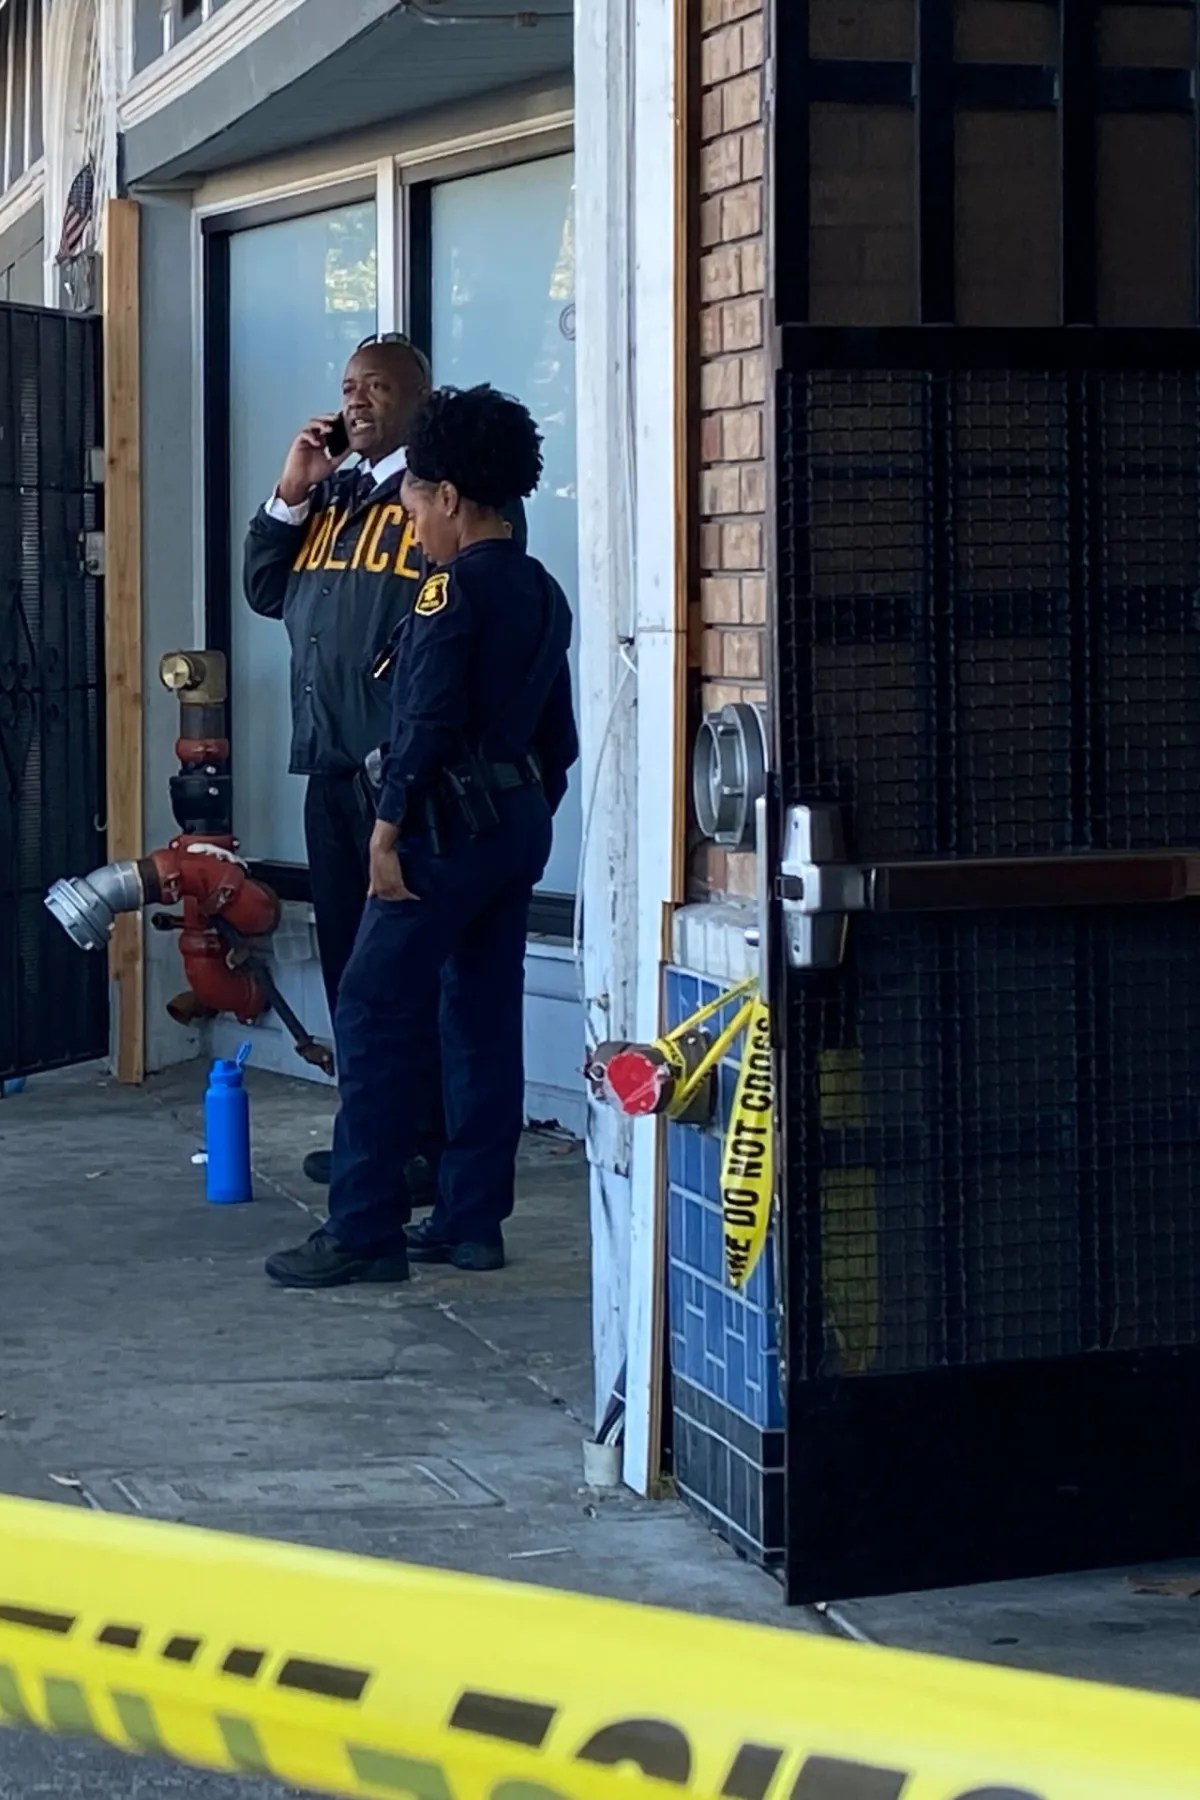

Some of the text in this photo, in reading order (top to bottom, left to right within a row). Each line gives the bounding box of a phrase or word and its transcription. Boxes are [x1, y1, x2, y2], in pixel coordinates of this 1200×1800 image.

[727, 1119, 767, 1178] NOT
[724, 1188, 760, 1227] DO
[726, 1233, 752, 1289] INE
